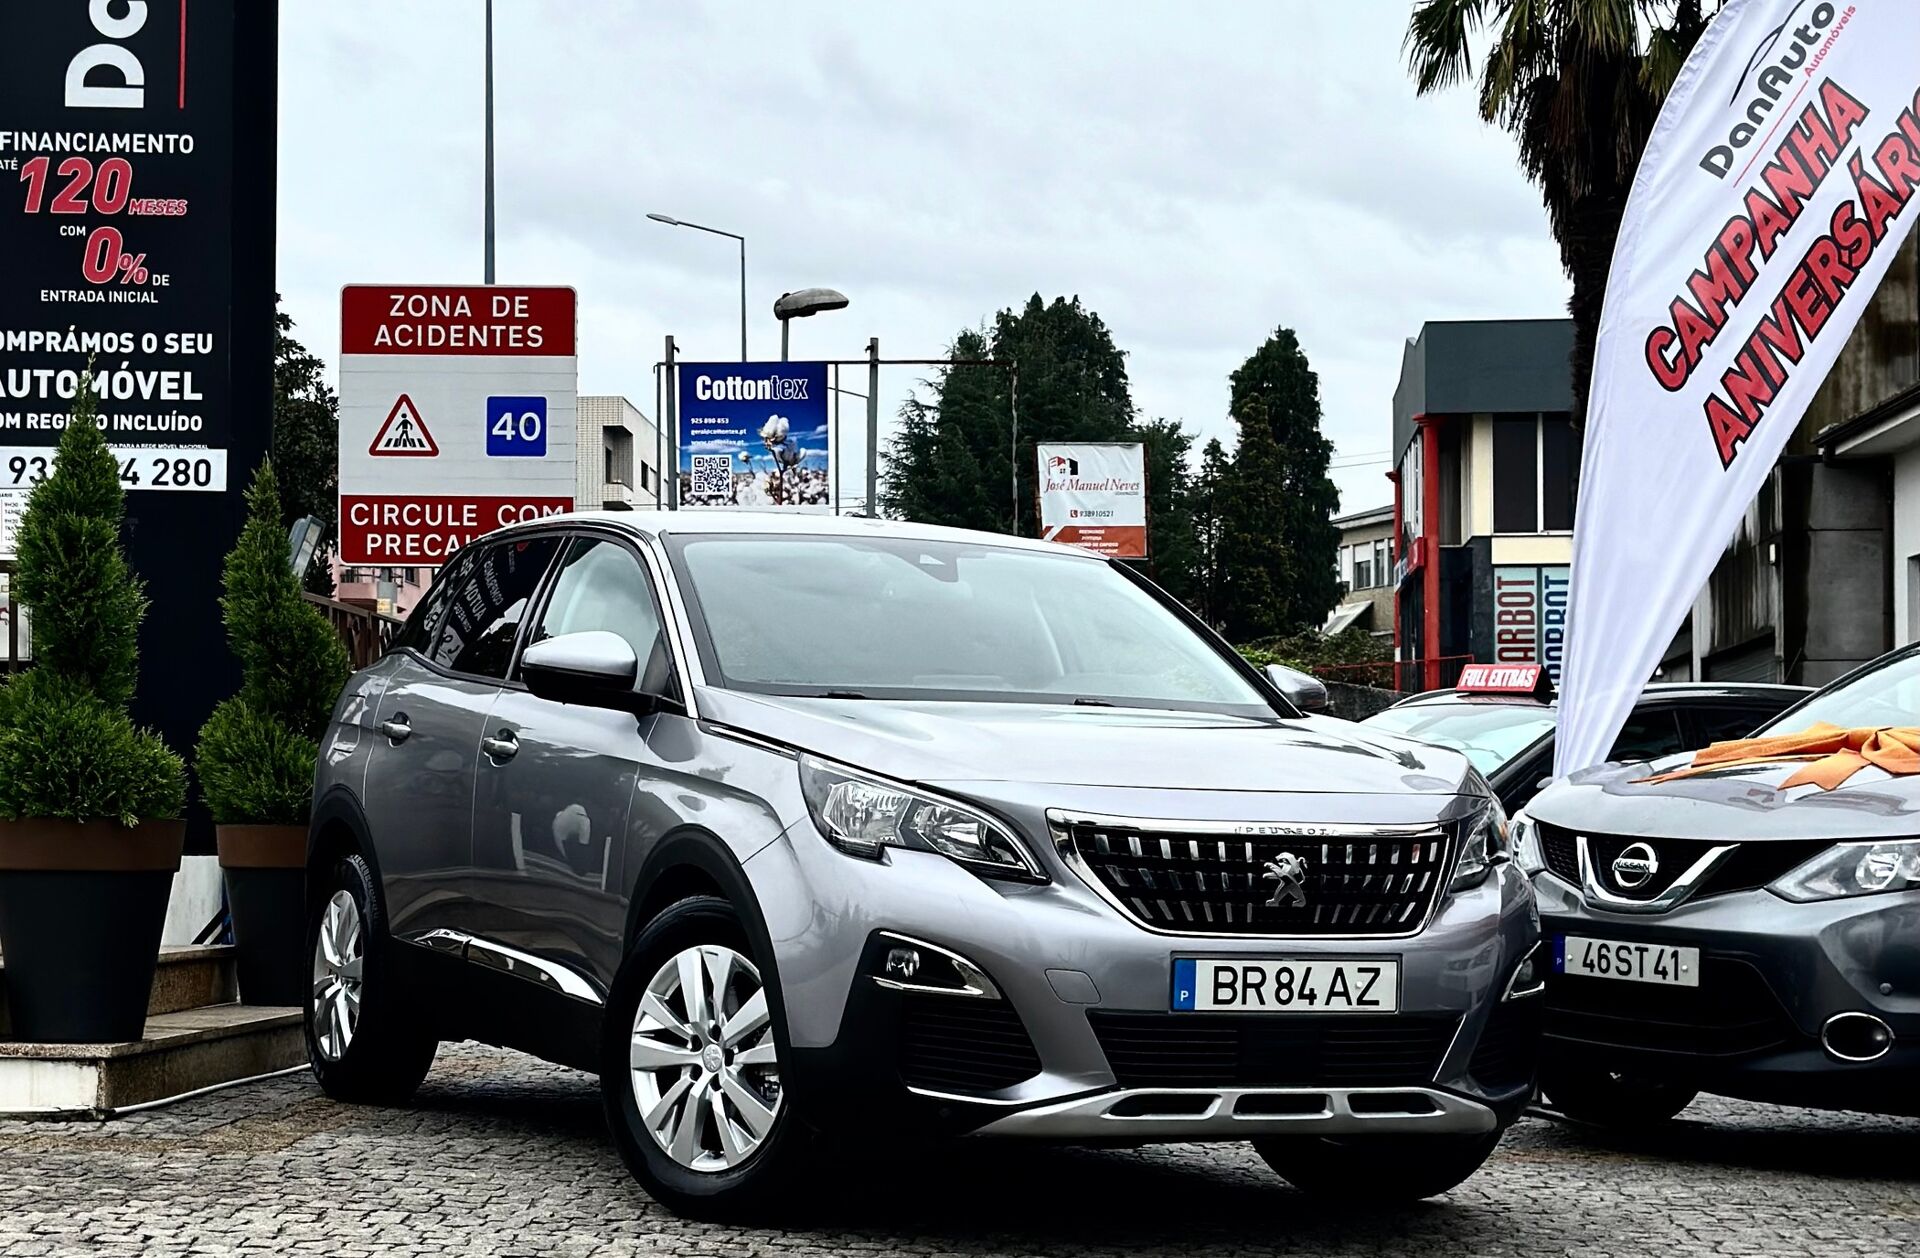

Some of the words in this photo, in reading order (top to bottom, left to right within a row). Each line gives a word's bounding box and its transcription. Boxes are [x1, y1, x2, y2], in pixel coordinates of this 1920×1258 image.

[1804, 5, 1856, 78] Automóveis
[1699, 2, 1834, 180] DanAuto
[0, 131, 194, 154] FINANCIAMENTO
[20, 156, 133, 215] 120
[128, 198, 188, 216] MESES
[1644, 76, 1870, 392] CAMPANHA
[60, 225, 86, 236] COM
[152, 274, 170, 286] DE
[40, 290, 104, 303] ENTRADA
[108, 291, 158, 304] INICIAL
[389, 294, 472, 318] ZONA
[492, 296, 530, 318] DE
[142, 333, 158, 354] O
[164, 333, 213, 354] SEU
[374, 324, 544, 348] ACIDENTES
[696, 375, 808, 401] Cottontex
[113, 410, 202, 432] INCLUÍDO
[492, 412, 542, 442] 40
[152, 458, 212, 486] 280
[1044, 477, 1066, 494] José
[1067, 478, 1109, 491] Manuel
[1110, 478, 1140, 491] Neves
[350, 503, 478, 526] CIRCULE
[1460, 669, 1490, 687] FULL
[1486, 669, 1536, 688] EXTRAS
[1246, 826, 1327, 836] PEUGEOT
[1180, 990, 1189, 1002] P
